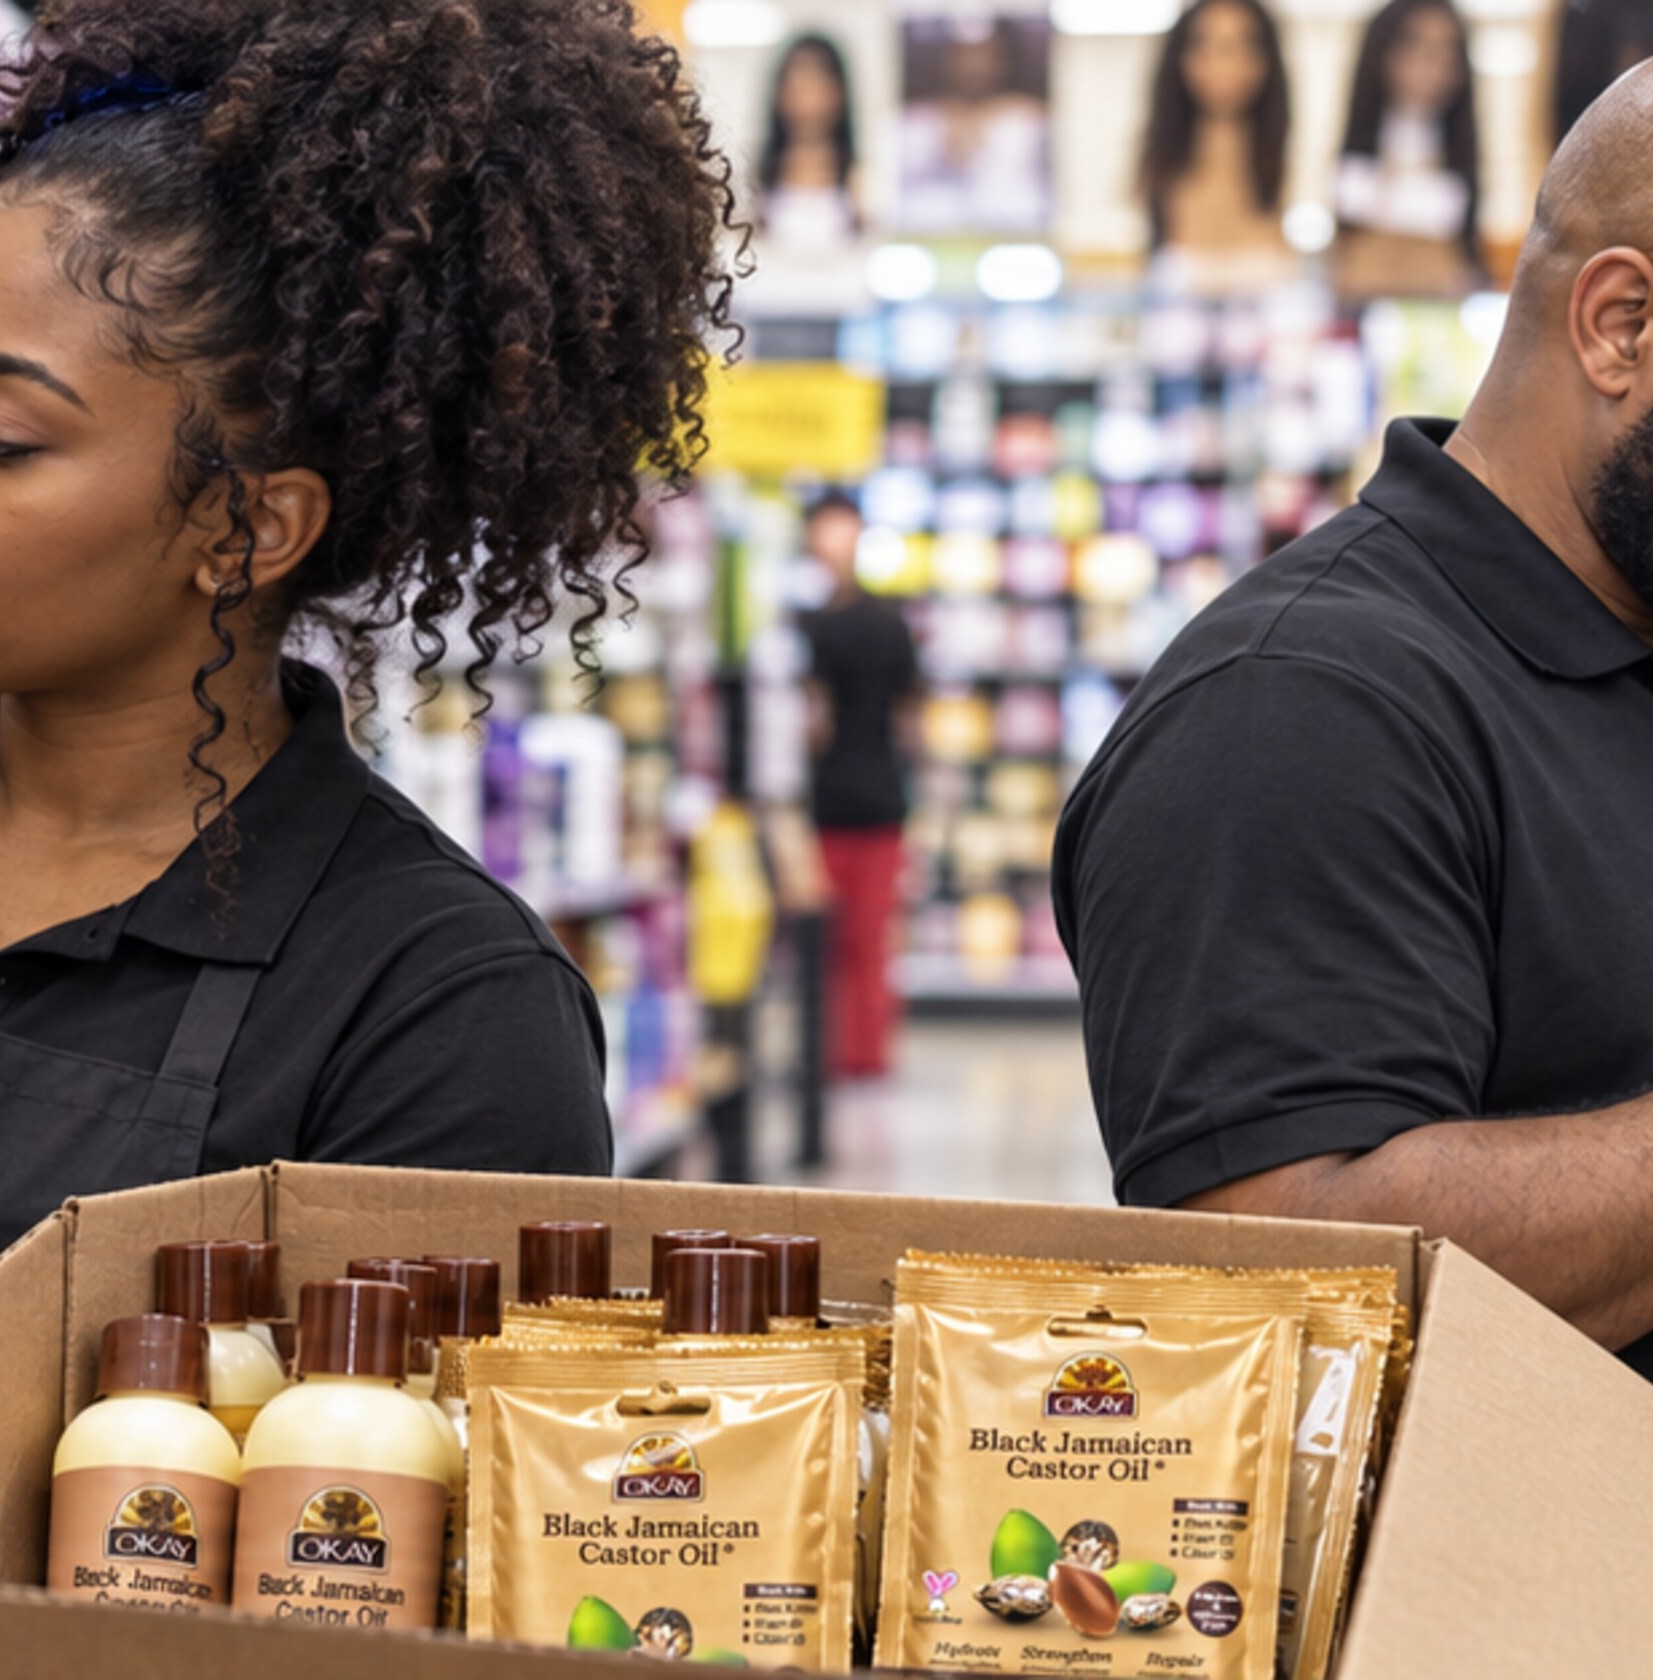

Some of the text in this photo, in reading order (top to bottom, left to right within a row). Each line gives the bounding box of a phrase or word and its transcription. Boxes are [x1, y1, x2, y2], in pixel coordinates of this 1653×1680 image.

[968, 1428, 1193, 1455] Black Jamaican
[1005, 1456, 1101, 1481] Castor
[542, 1512, 760, 1539] Black Jamaican
[115, 1531, 192, 1560] OKAY
[297, 1536, 381, 1565] OKAY
[578, 1541, 671, 1566] Castor
